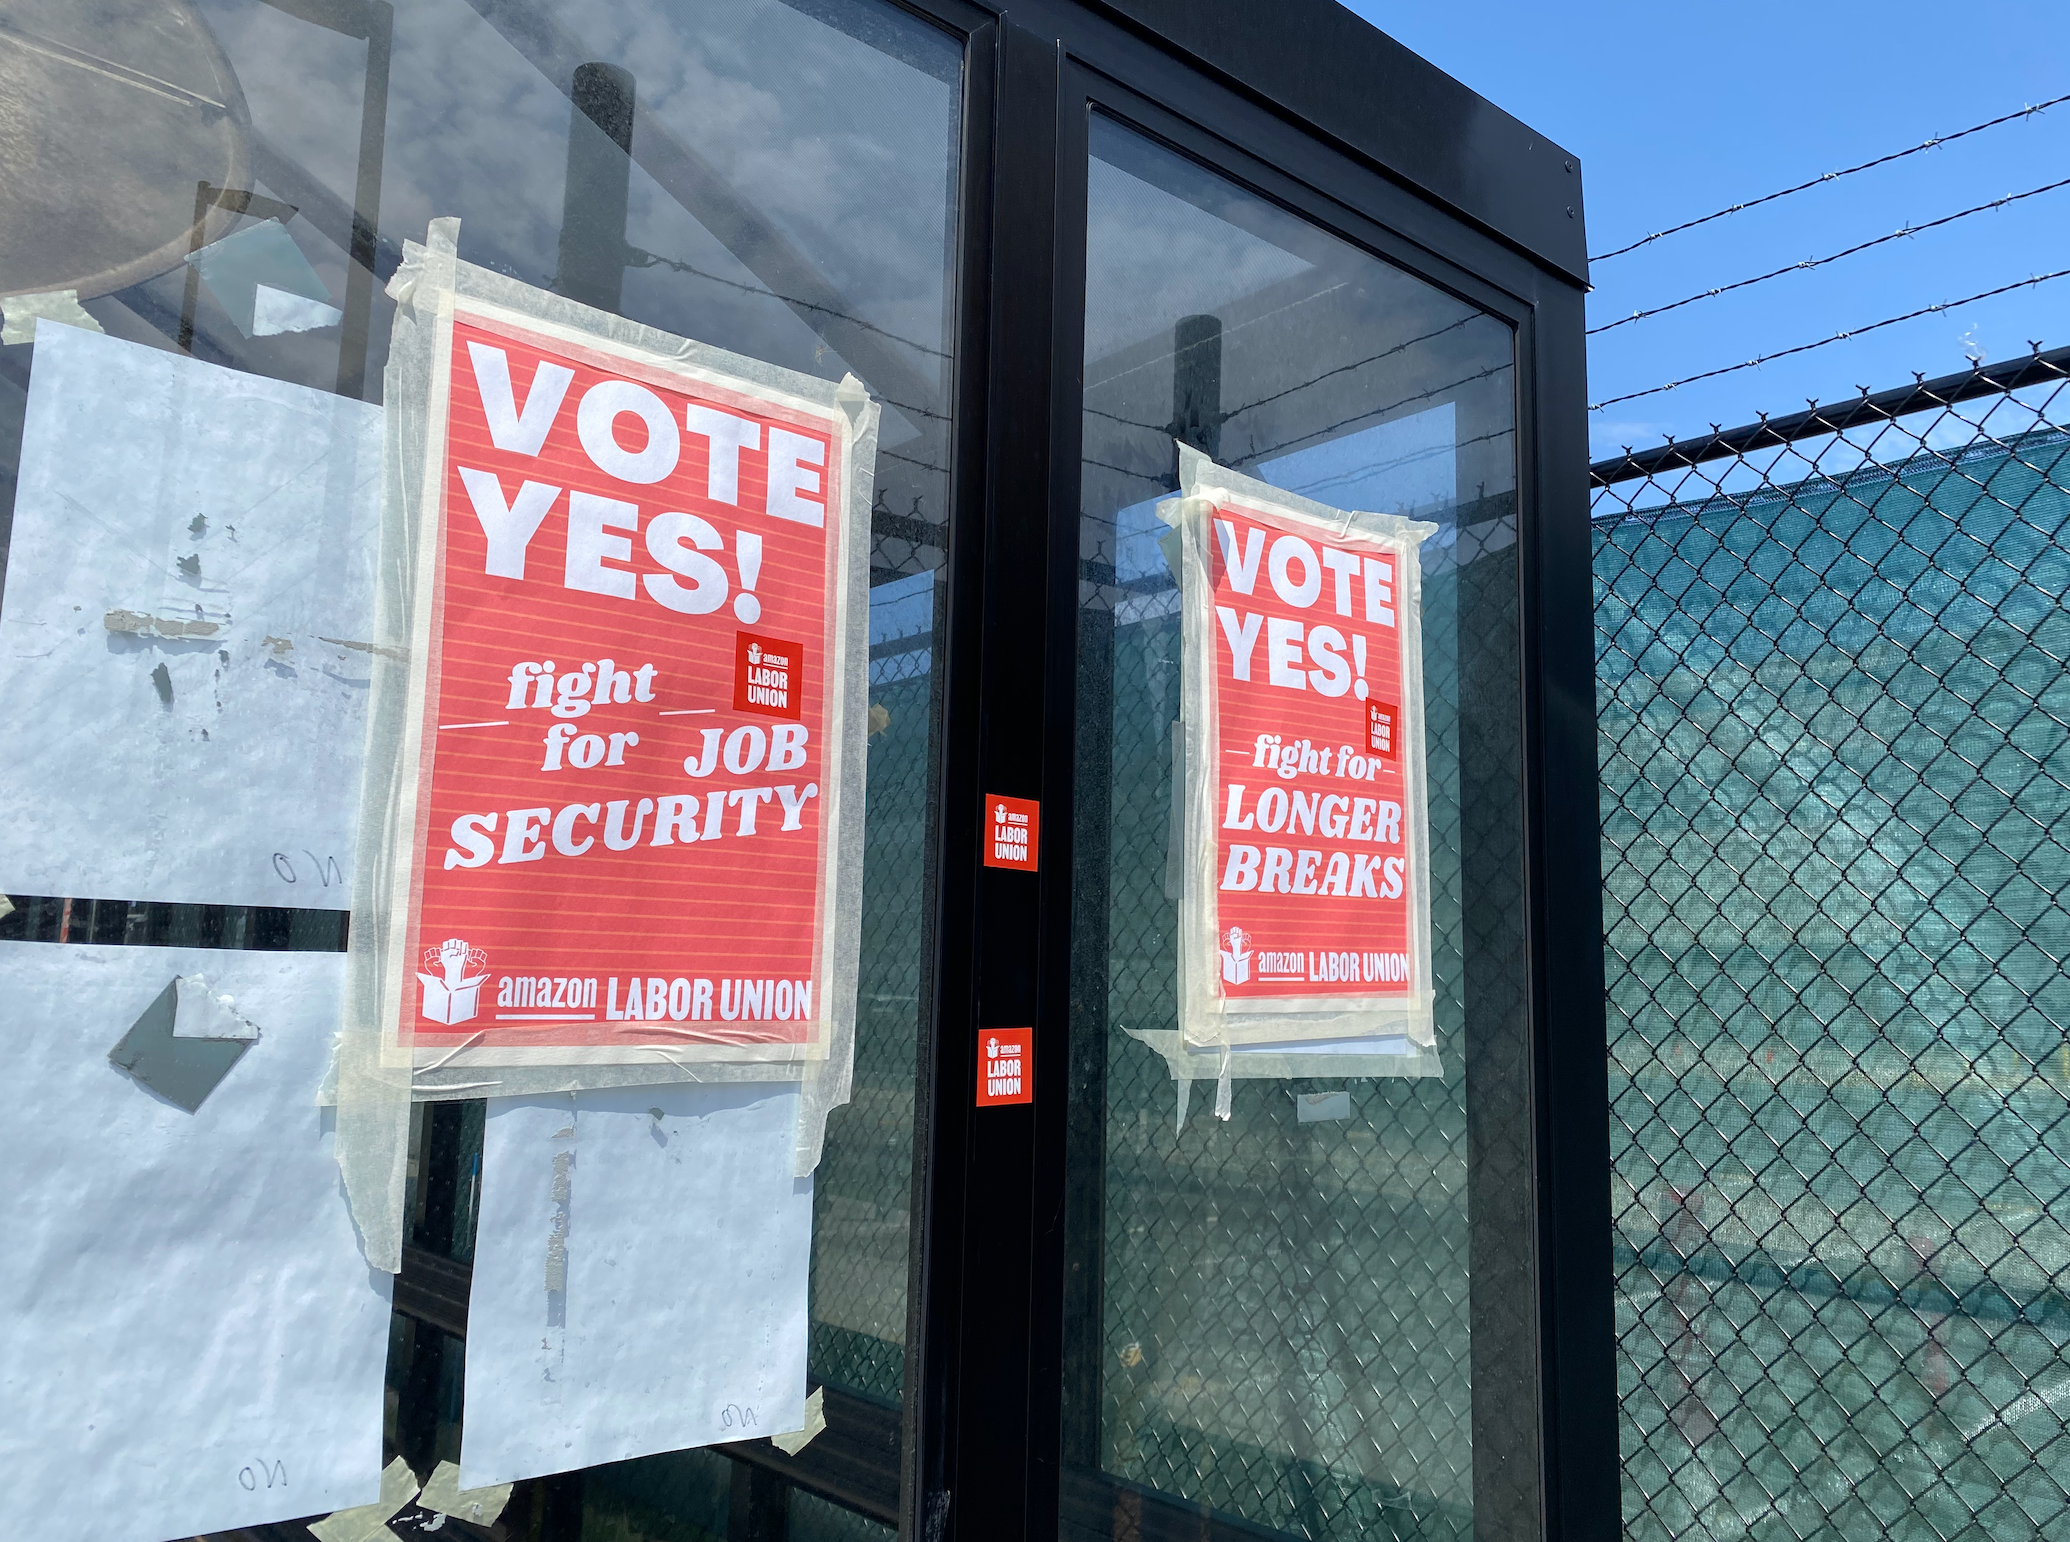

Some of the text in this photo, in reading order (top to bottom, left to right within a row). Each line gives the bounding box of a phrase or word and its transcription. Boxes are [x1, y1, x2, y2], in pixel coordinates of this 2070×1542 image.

[466, 340, 825, 528] VOTE
[457, 466, 763, 625] YES!
[1212, 518, 1395, 628] VOTE
[763, 653, 789, 667] amazon
[1214, 606, 1369, 701] YES!
[505, 658, 658, 719] fight
[747, 665, 788, 690] LABOR
[747, 684, 788, 709] UNION
[540, 722, 809, 778] for JOB
[1370, 721, 1391, 739] LABOR
[1370, 735, 1391, 753] UNION
[1252, 733, 1382, 781] fight for
[443, 782, 819, 871] SECURITY
[994, 824, 1028, 844] LABOR
[1222, 783, 1402, 845] LONGER
[994, 842, 1028, 862] UNION
[1219, 844, 1405, 900] BREAKS
[1258, 951, 1410, 982] amazon LABOR UNION
[495, 975, 812, 1021] amazon LABOR UNION
[987, 1059, 1022, 1078] LABOR
[987, 1077, 1022, 1097] UNION
